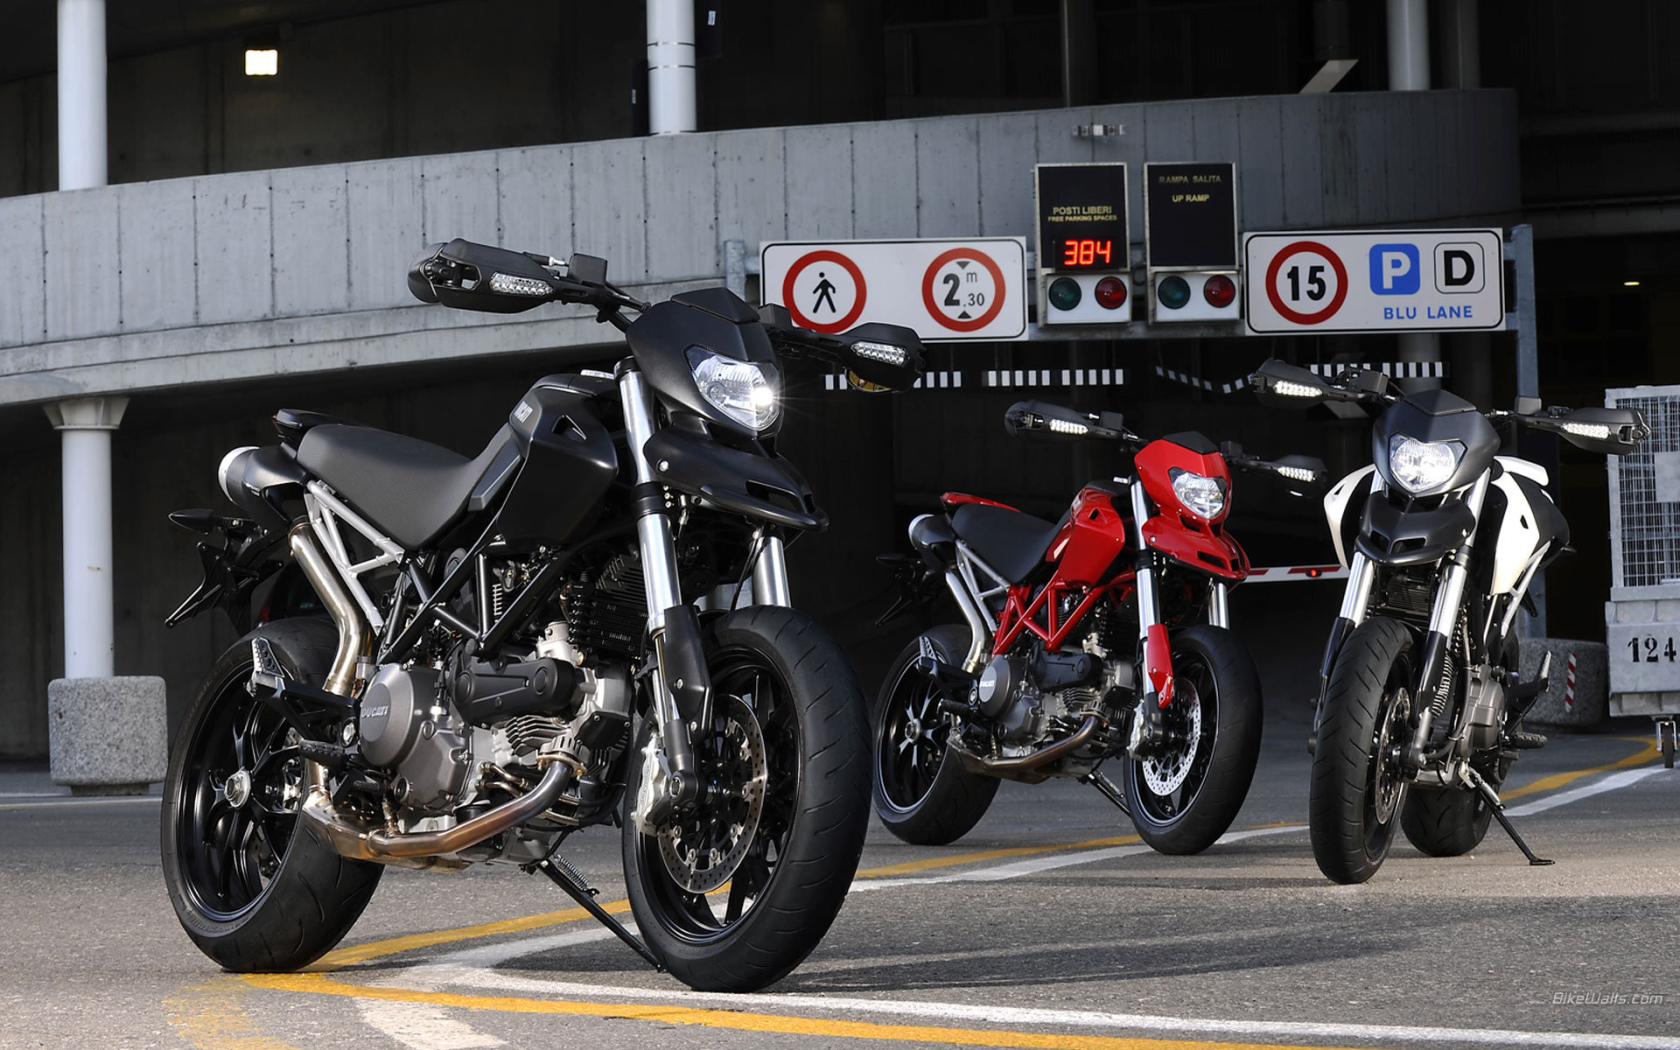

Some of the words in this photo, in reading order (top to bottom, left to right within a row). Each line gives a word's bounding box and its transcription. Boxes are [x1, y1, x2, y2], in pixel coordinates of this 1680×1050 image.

[1158, 175, 1189, 184] RAMPA
[1192, 174, 1222, 184] SALITA
[1172, 194, 1184, 203] UP
[1185, 193, 1210, 202] RAMP
[1052, 206, 1081, 216] POSTI
[1082, 205, 1112, 215] LIBERI
[1064, 239, 1112, 266] 384
[1381, 251, 1412, 290] P
[1443, 249, 1476, 287] D
[1286, 265, 1327, 302] 15
[1383, 306, 1417, 321] BLU
[1427, 305, 1473, 320] LANE
[1627, 636, 1677, 663] 124
[361, 705, 389, 718] DUCATI
